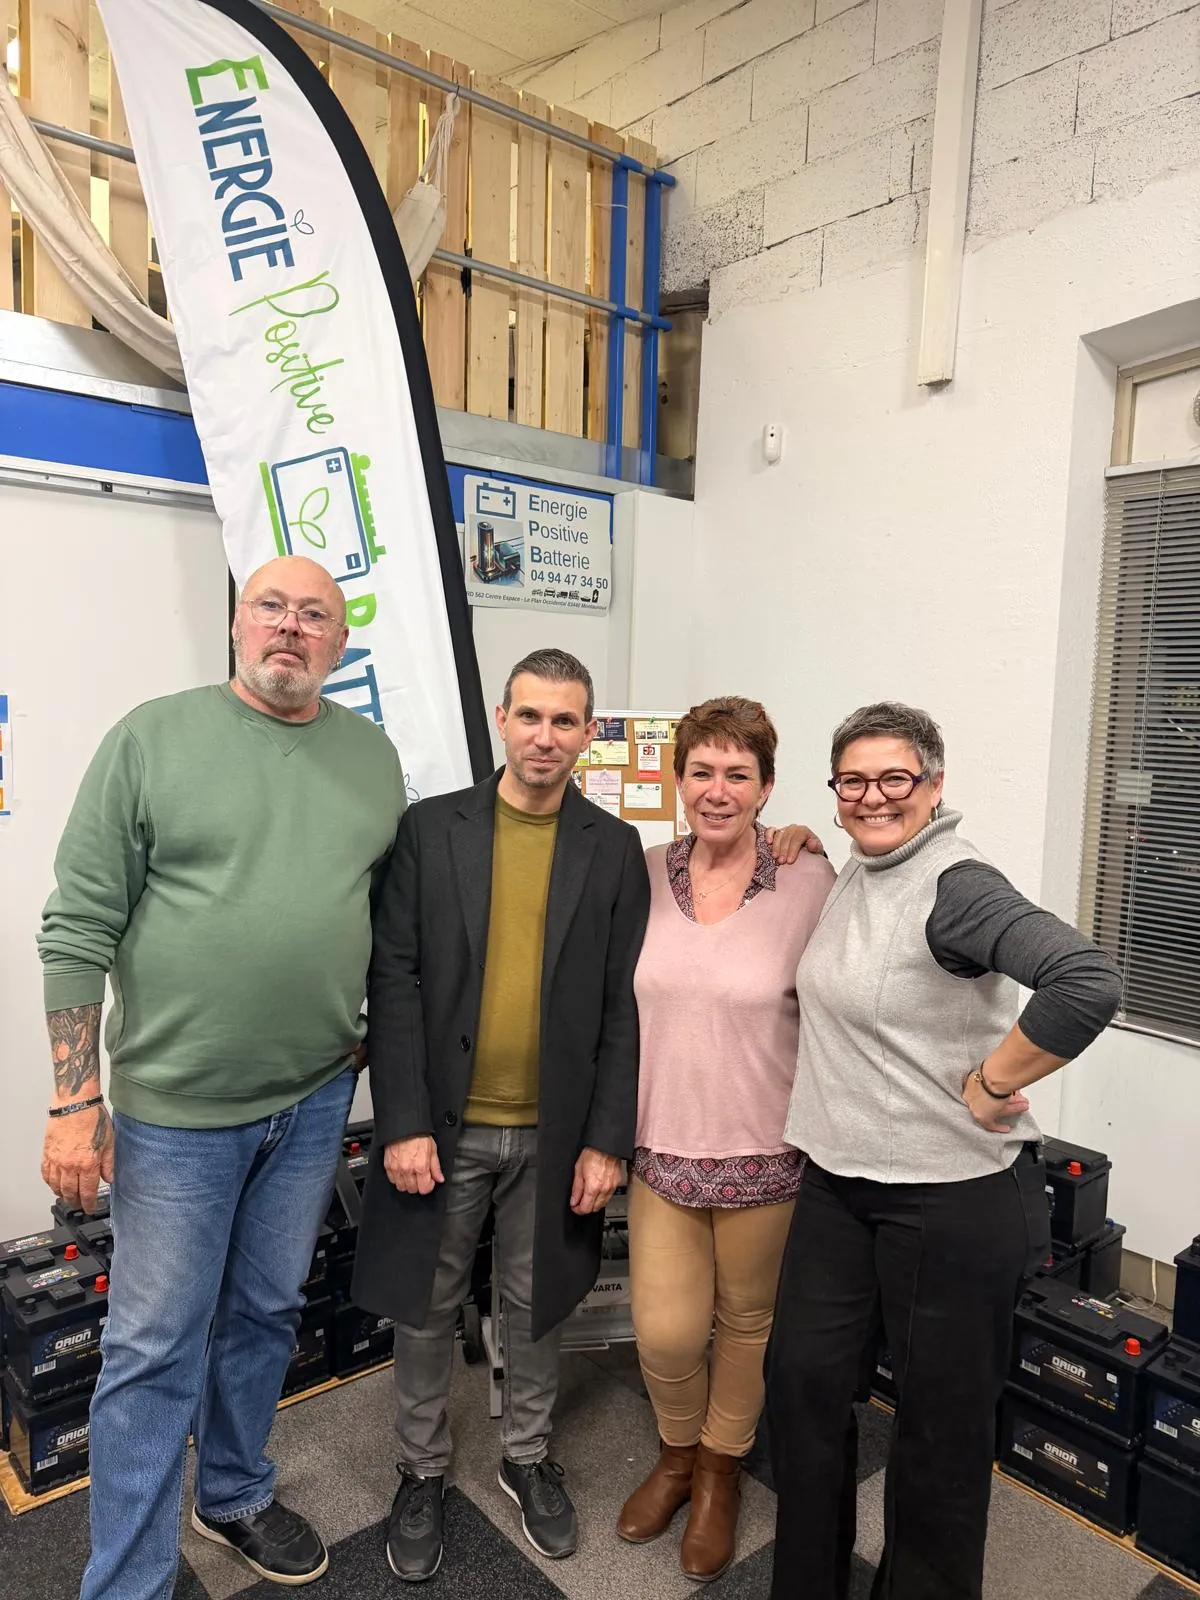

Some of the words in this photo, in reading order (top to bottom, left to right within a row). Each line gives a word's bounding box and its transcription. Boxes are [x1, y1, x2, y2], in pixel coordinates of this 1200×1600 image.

[185, 55, 295, 282] ENERGIE
[228, 270, 344, 435] Positive
[529, 494, 588, 521] Energie
[529, 520, 589, 545] Positive
[530, 545, 590, 570] Batterie
[531, 569, 545, 583] 04
[547, 571, 561, 584] 94
[564, 573, 578, 586] 47
[580, 575, 594, 588] 34
[595, 577, 609, 590] 50
[503, 594, 521, 602] Espace
[592, 1283, 622, 1293] VARTA
[55, 1330, 92, 1350] ORION
[1051, 1355, 1087, 1379] ORION
[1043, 1441, 1078, 1466] ORION
